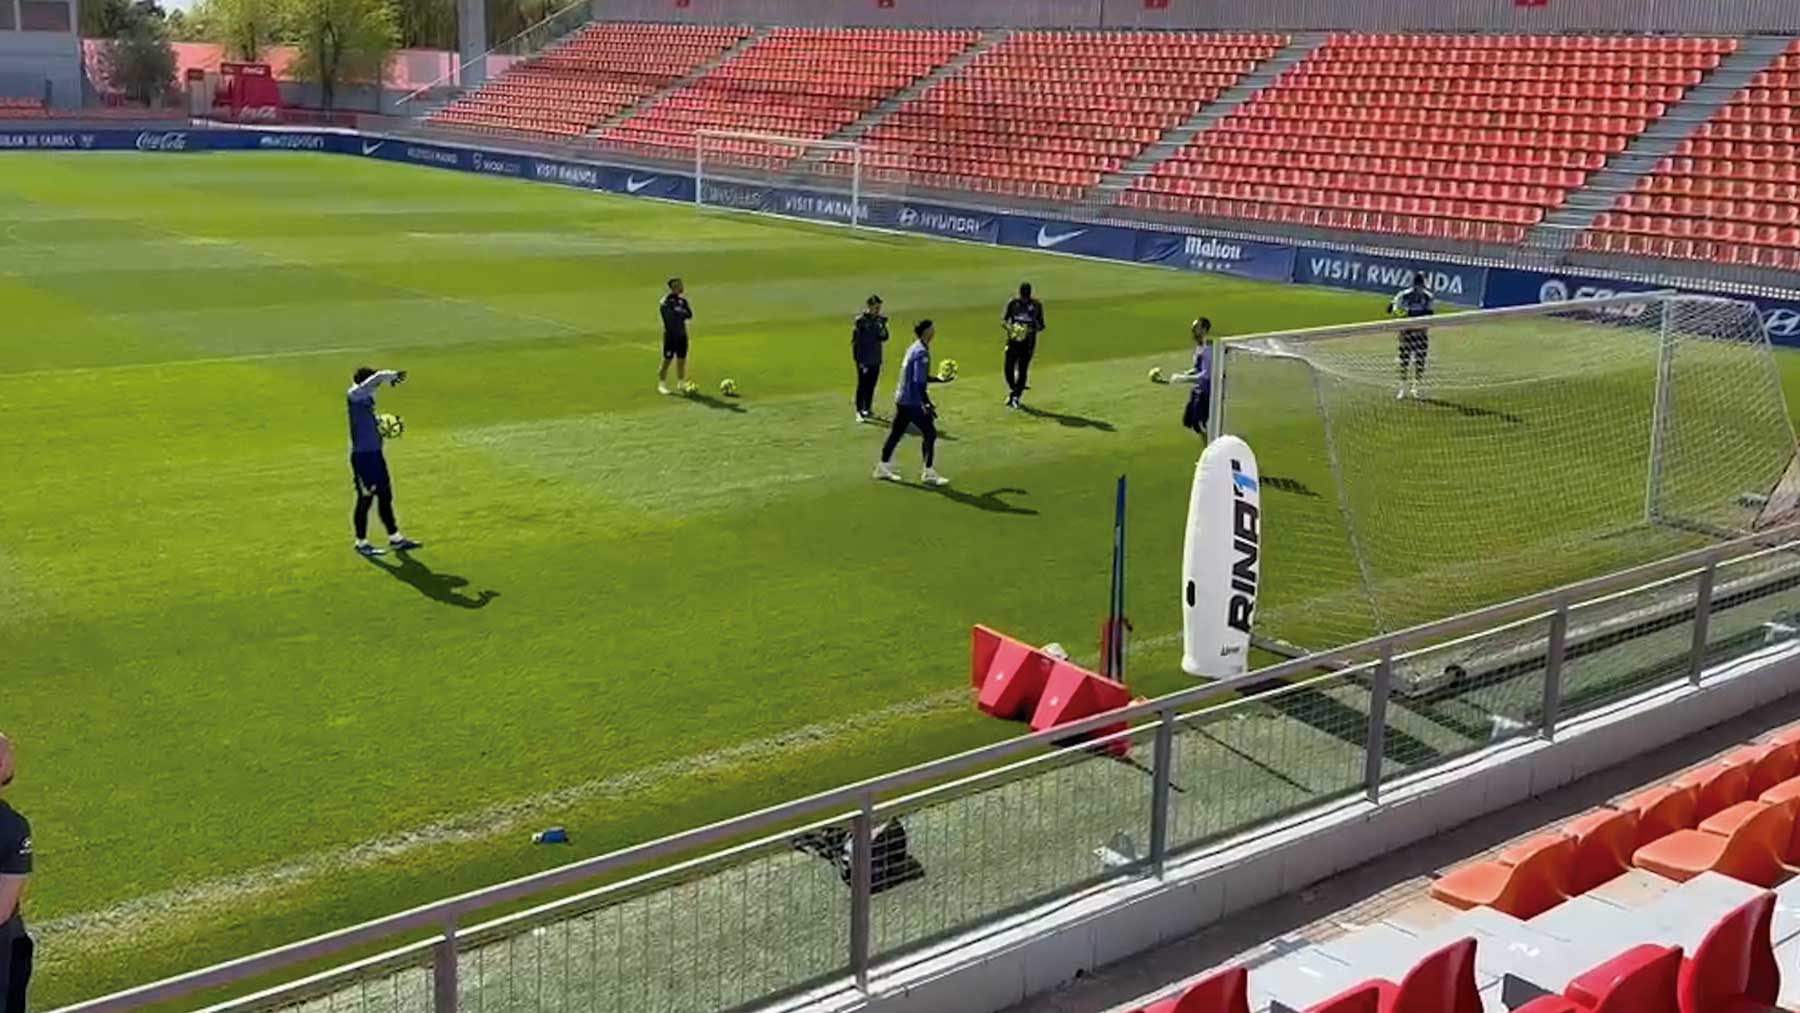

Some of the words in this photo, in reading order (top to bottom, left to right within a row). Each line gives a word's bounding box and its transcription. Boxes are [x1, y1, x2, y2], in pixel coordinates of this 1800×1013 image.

[785, 196, 814, 213] VISIT
[919, 211, 980, 232] HYUNDAI
[1310, 257, 1362, 281] VISIT
